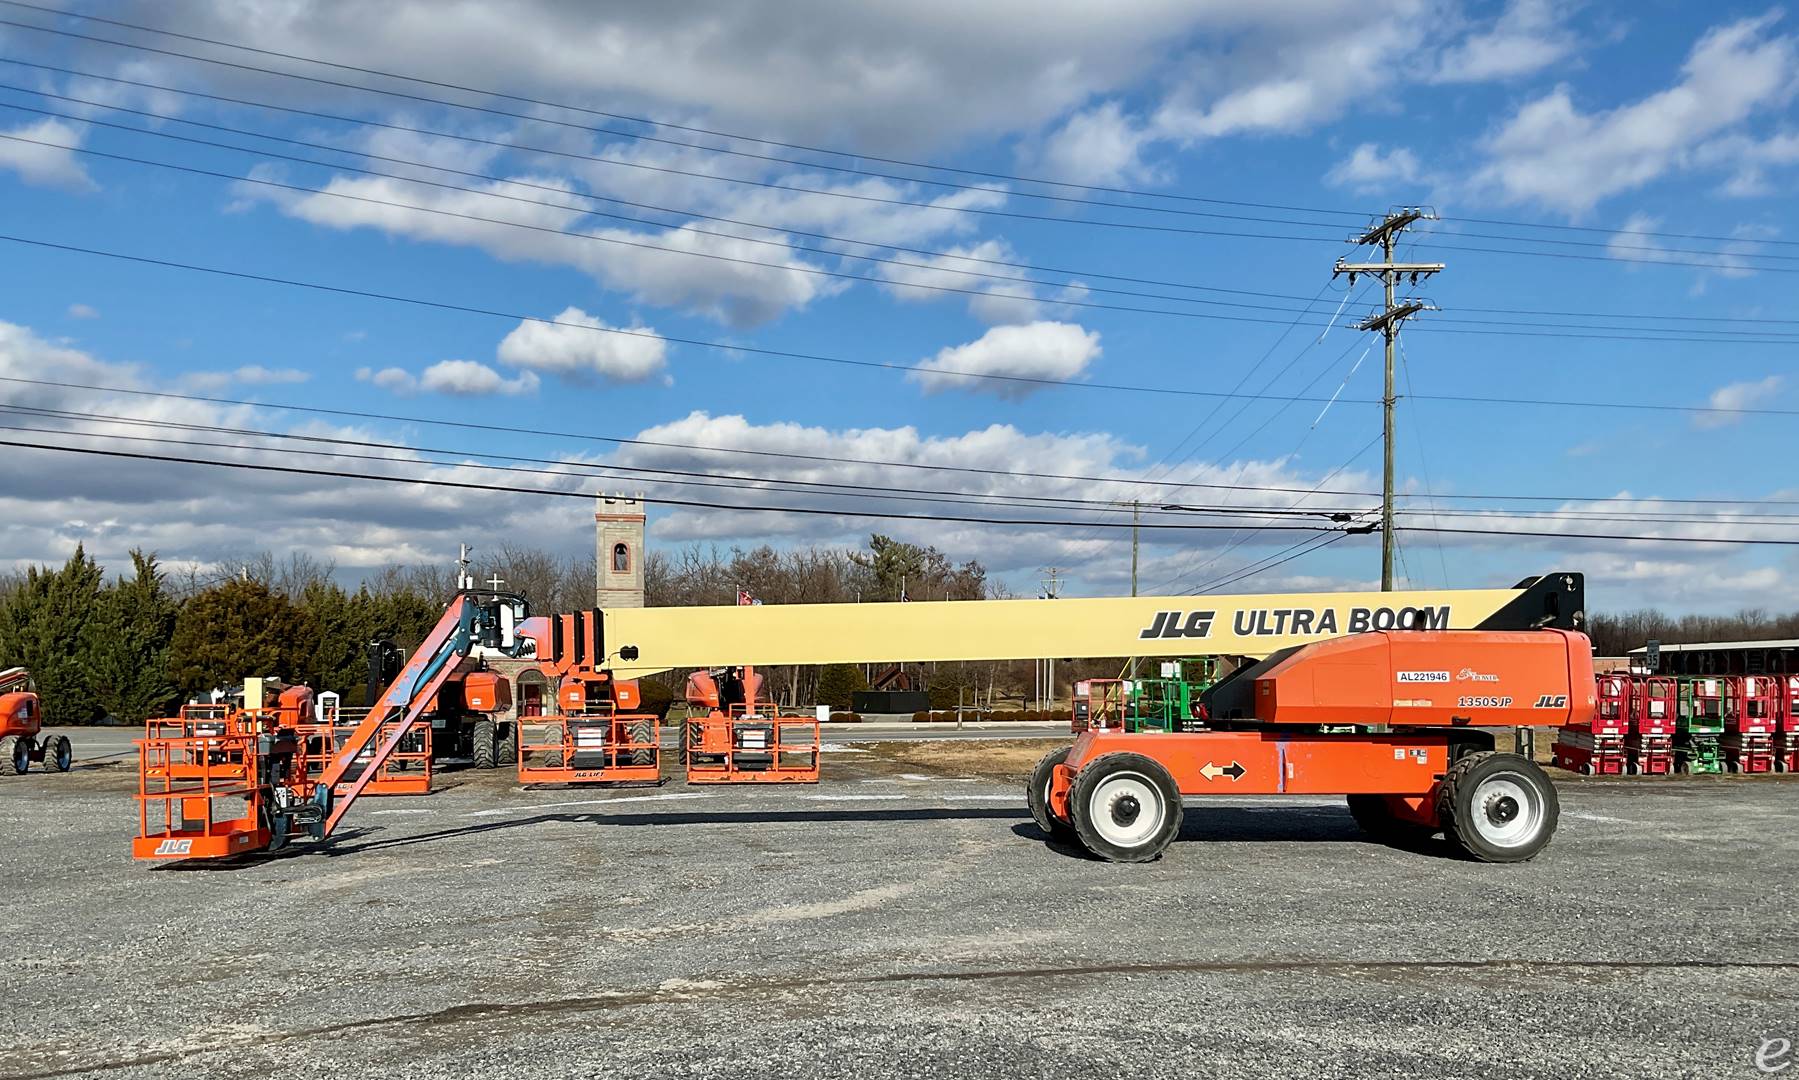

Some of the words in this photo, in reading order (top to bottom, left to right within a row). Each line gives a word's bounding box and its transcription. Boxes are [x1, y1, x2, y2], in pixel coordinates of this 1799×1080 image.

[1140, 611, 1215, 638] JLG
[1234, 609, 1337, 636] ULTRA
[1349, 607, 1450, 633] BOOM
[1400, 672, 1448, 681] AL221946
[1459, 697, 1512, 707] 1350SJP
[1535, 696, 1566, 707] JLG
[156, 840, 192, 854] JLG
